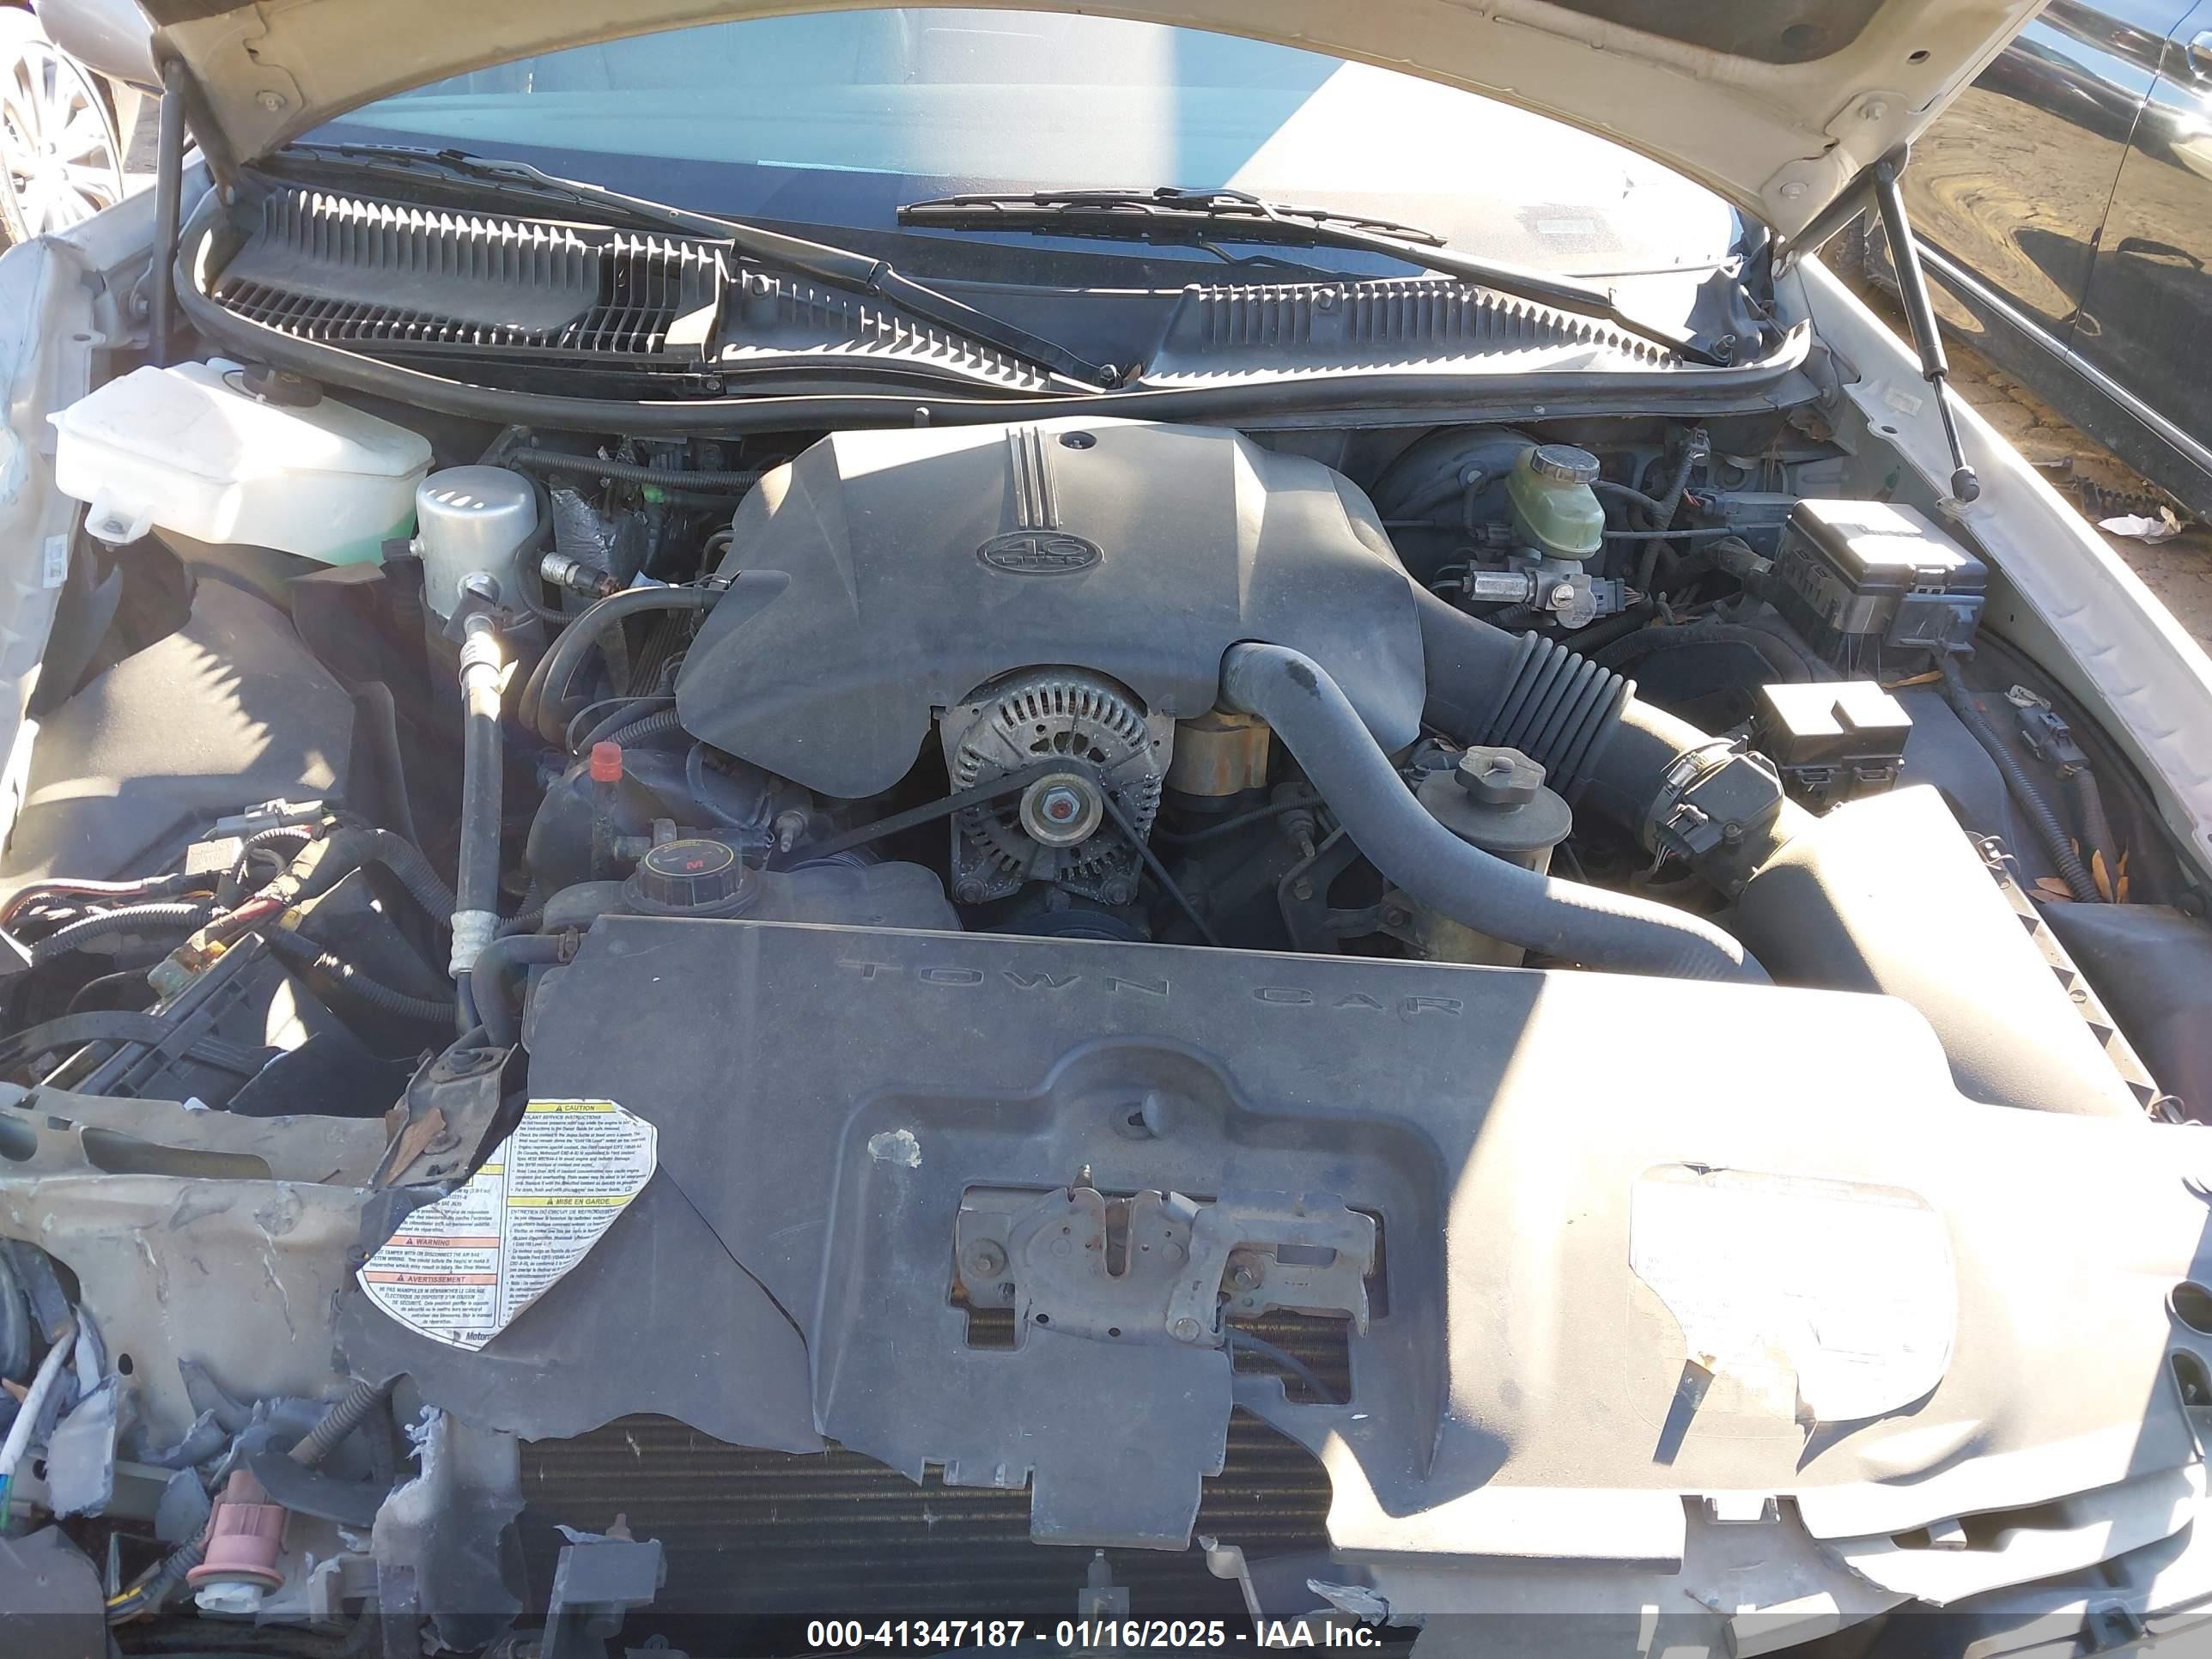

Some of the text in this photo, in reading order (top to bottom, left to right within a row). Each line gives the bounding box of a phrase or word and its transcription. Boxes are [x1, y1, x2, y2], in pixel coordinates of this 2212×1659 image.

[838, 960, 1465, 1017] TOWN CAR
[465, 1332, 492, 1340] Motor
